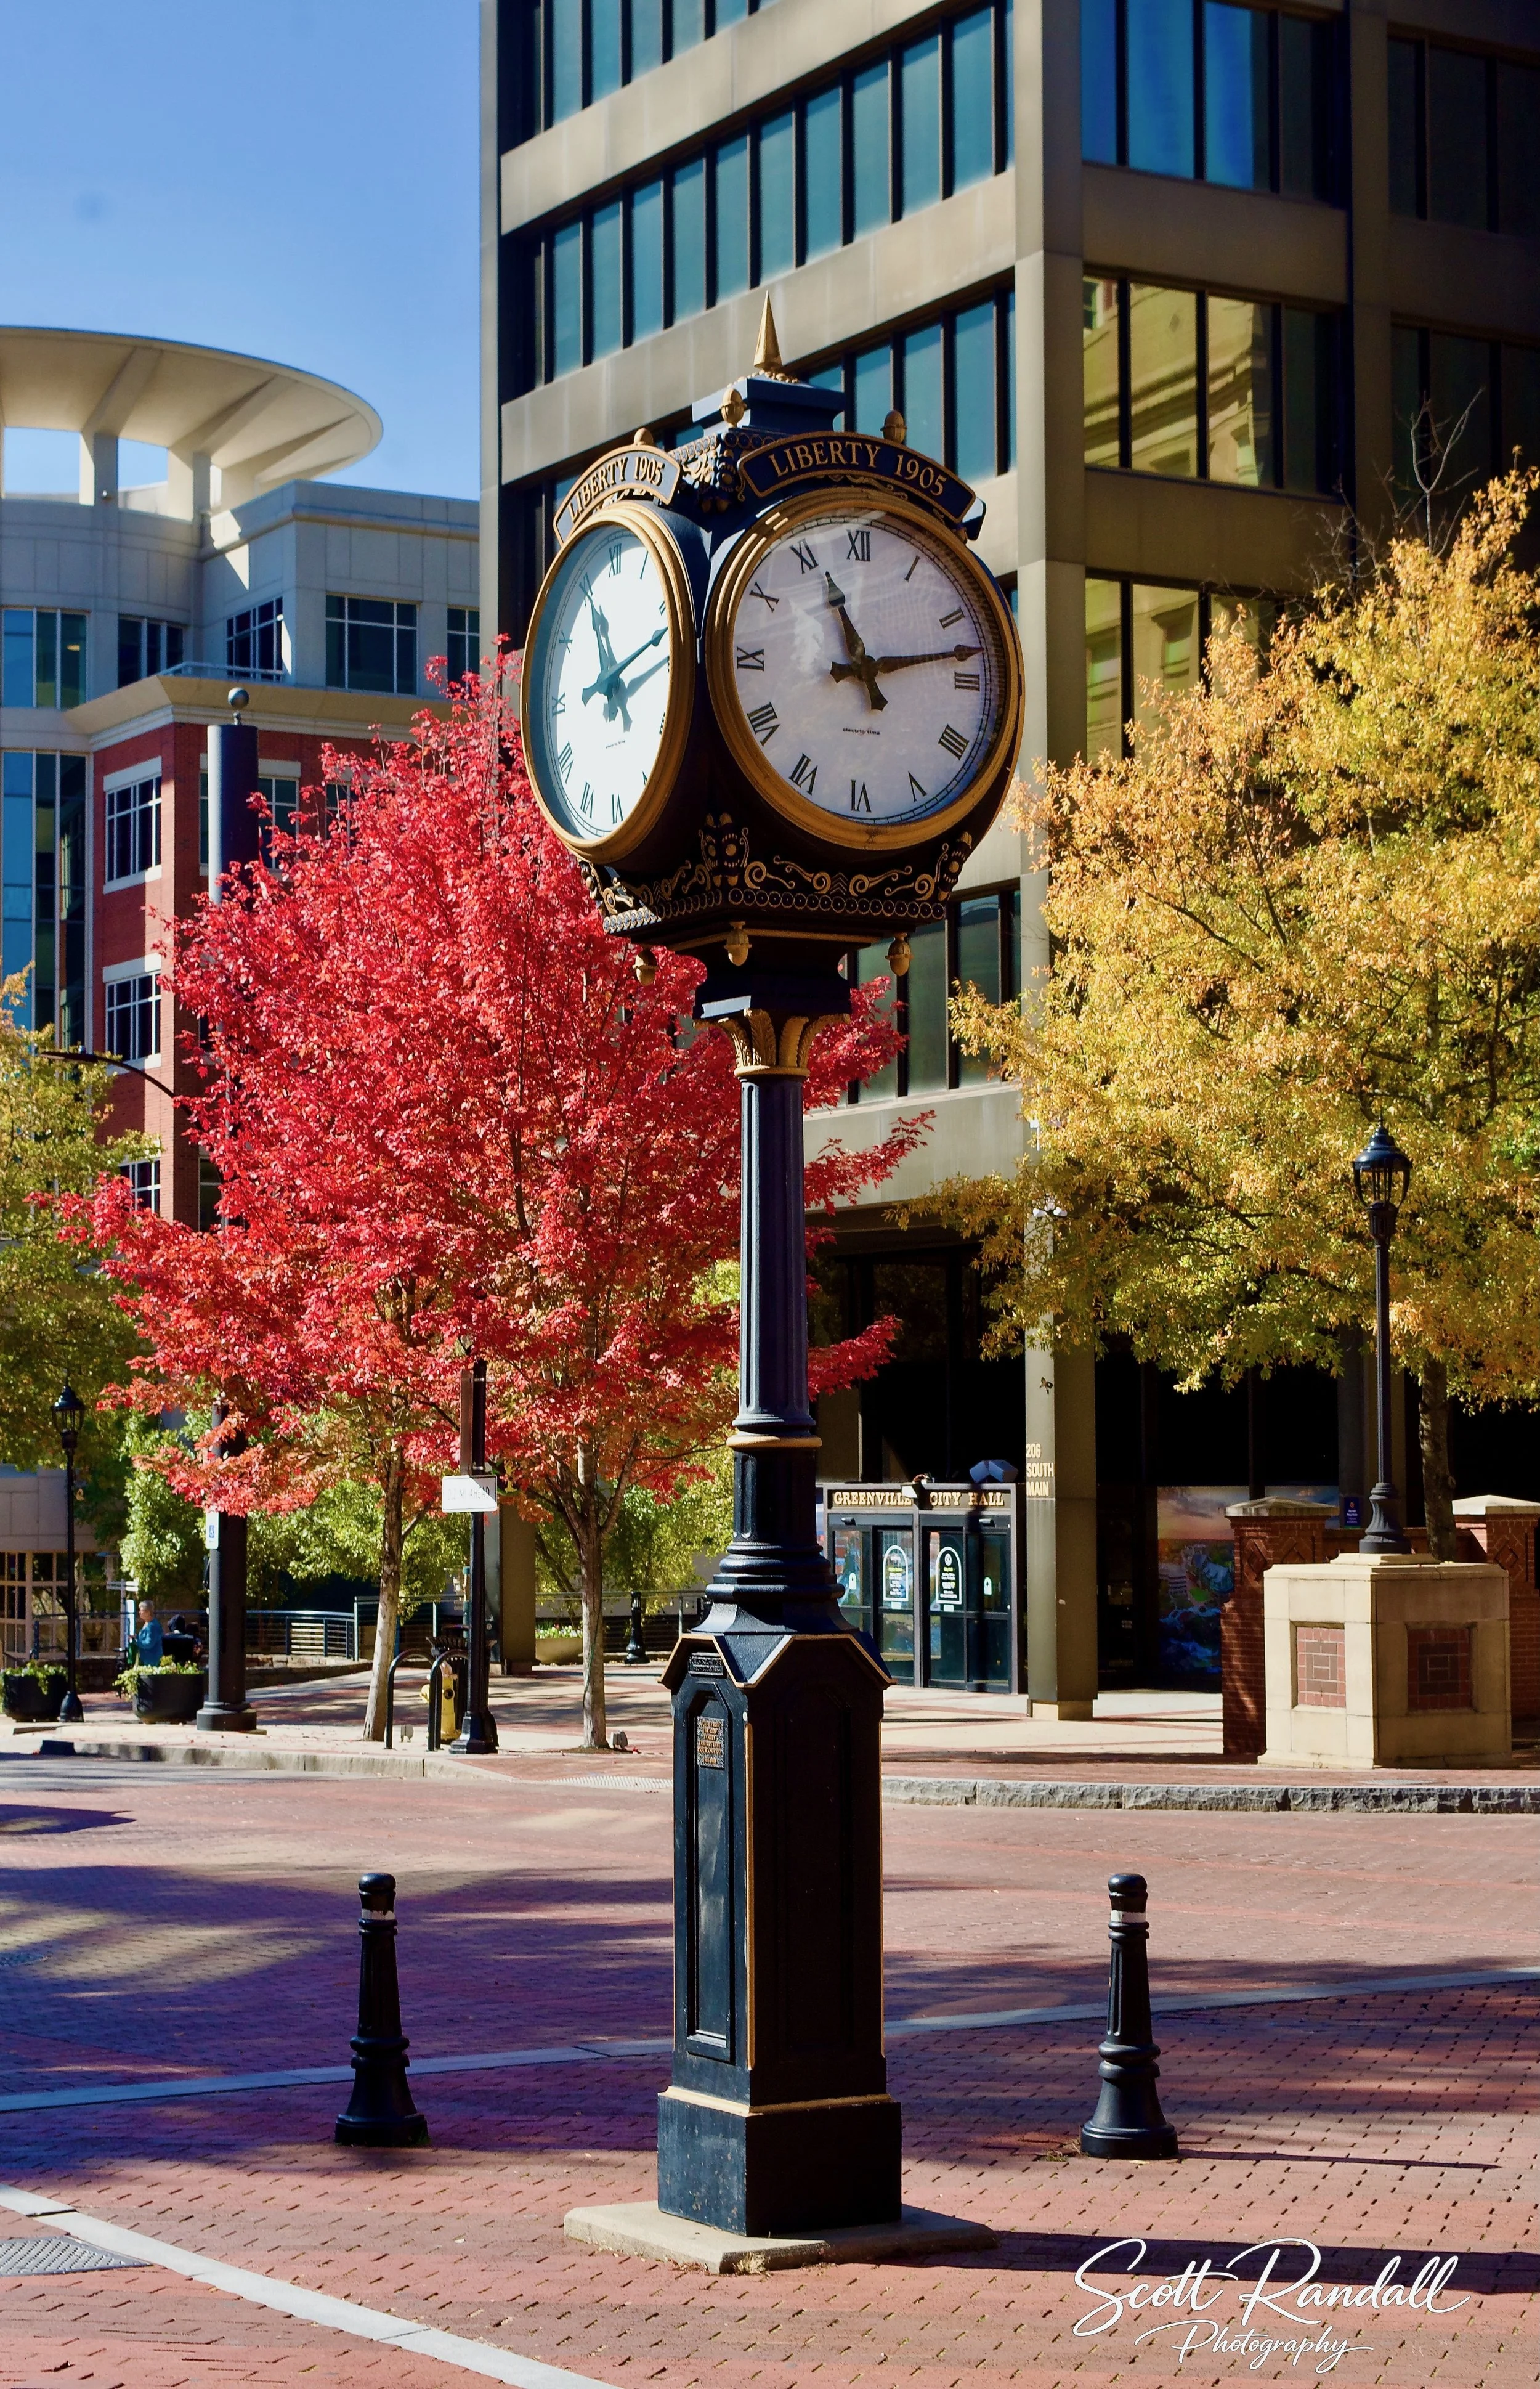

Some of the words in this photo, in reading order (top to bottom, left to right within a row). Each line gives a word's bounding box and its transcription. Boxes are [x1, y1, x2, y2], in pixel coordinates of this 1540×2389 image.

[768, 441, 881, 477] LIBERTY
[894, 454, 947, 496] 1905
[568, 457, 628, 523] LIBERTY
[634, 455, 665, 486] 1905
[608, 543, 622, 578] XII
[790, 538, 819, 574] XI
[846, 529, 870, 562] XII
[903, 555, 920, 582] I
[749, 582, 780, 613] X
[939, 607, 965, 629] II
[736, 646, 764, 671] IX
[954, 672, 980, 691] III
[747, 702, 781, 746] VIII
[938, 724, 970, 760] IIII
[788, 753, 818, 796] VII
[907, 771, 928, 802] V
[611, 794, 624, 824] VI
[849, 779, 872, 813] VI
[1026, 1443, 1041, 1458] 206
[1026, 1463, 1054, 1478] SOUTH
[930, 1492, 961, 1507] CITY
[968, 1492, 1003, 1507] HALL
[1026, 1481, 1049, 1496] MAIN
